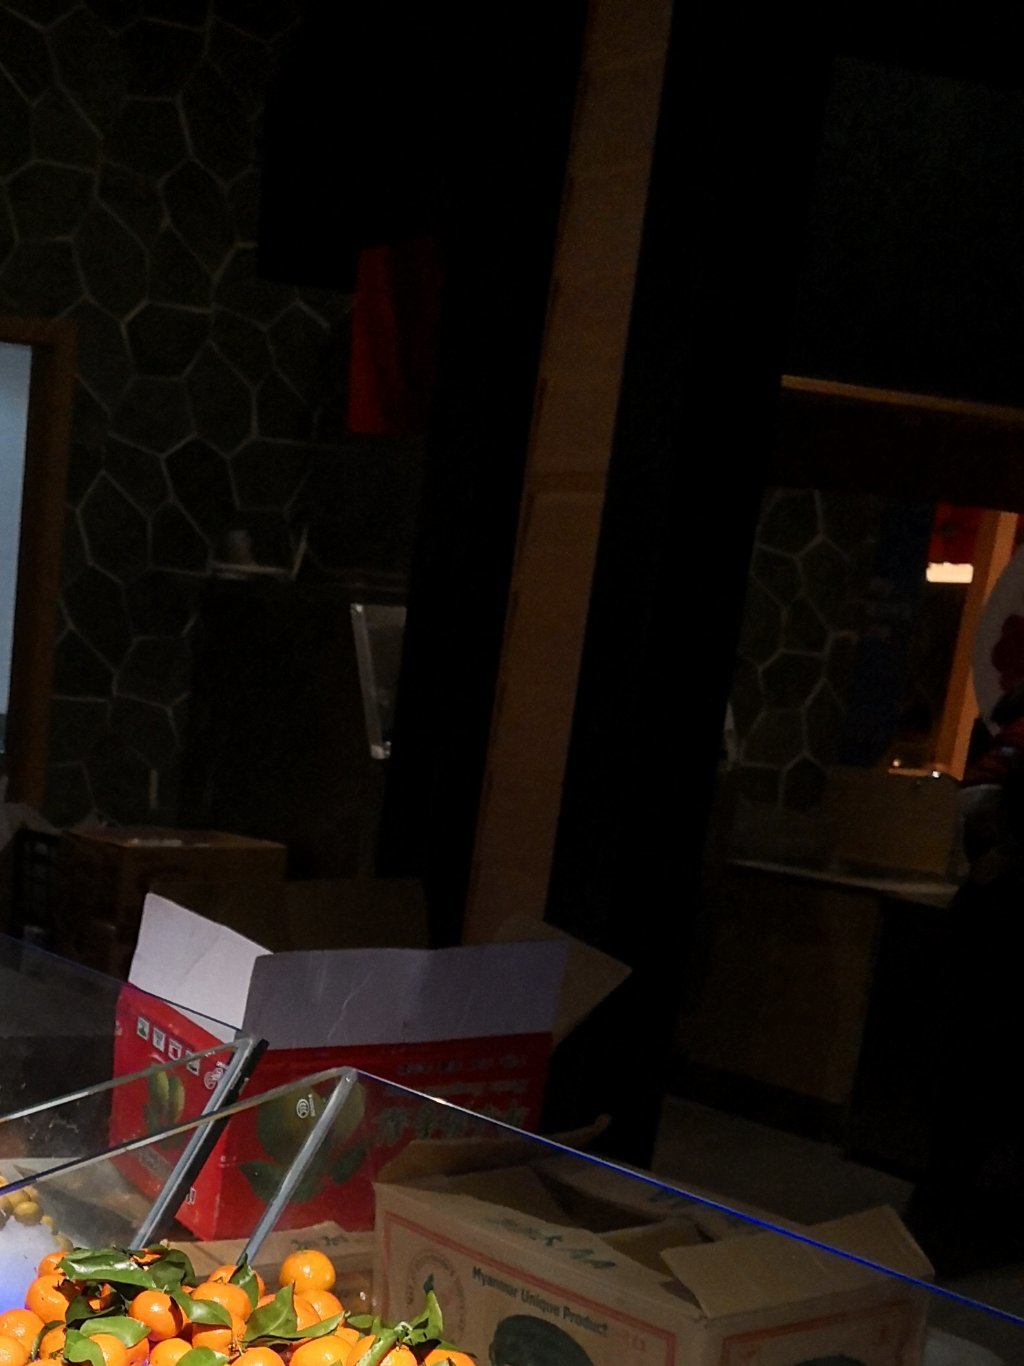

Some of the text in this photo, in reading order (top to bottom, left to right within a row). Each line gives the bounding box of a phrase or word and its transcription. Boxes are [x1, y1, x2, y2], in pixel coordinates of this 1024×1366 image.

[472, 1266, 608, 1336] Myanmar Unique Product
